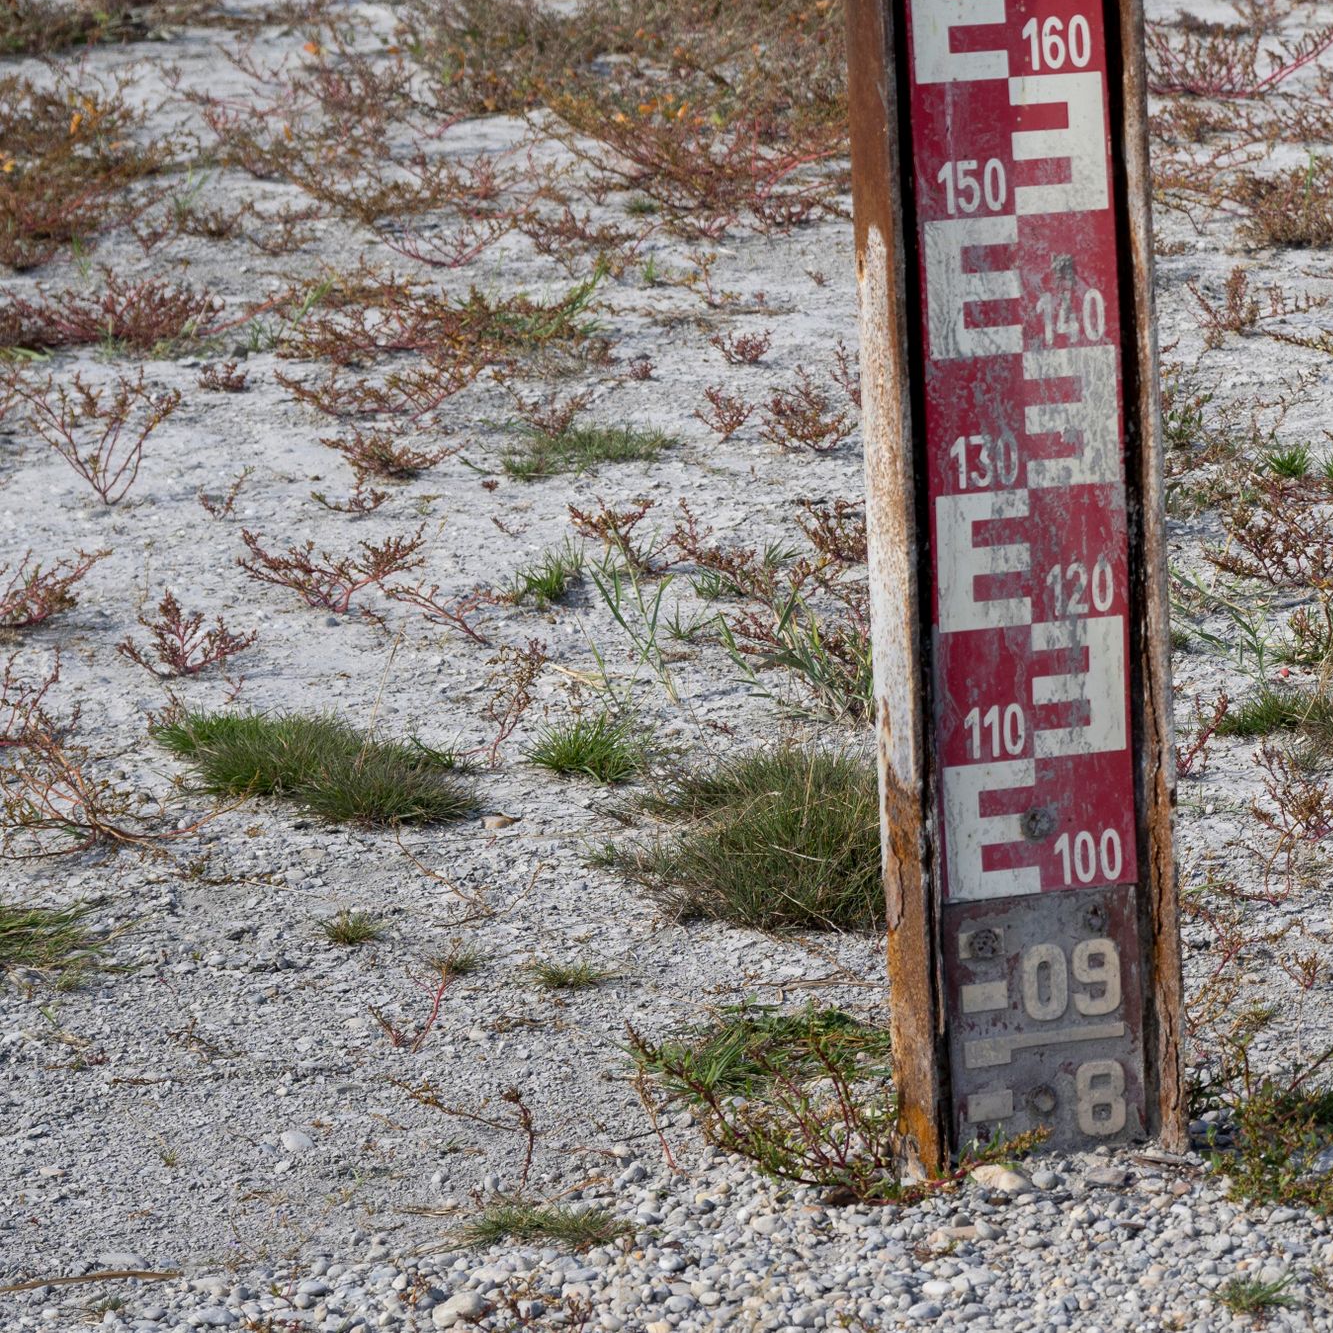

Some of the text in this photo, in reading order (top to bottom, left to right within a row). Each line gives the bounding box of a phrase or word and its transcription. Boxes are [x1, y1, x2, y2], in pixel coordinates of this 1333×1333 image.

[1022, 14, 1091, 71] 160
[937, 157, 1007, 215] 150
[1035, 289, 1105, 347] 140
[950, 434, 1019, 490] 130
[1046, 561, 1114, 617] 120
[964, 702, 1025, 760] 110
[1053, 827, 1123, 885] 100
